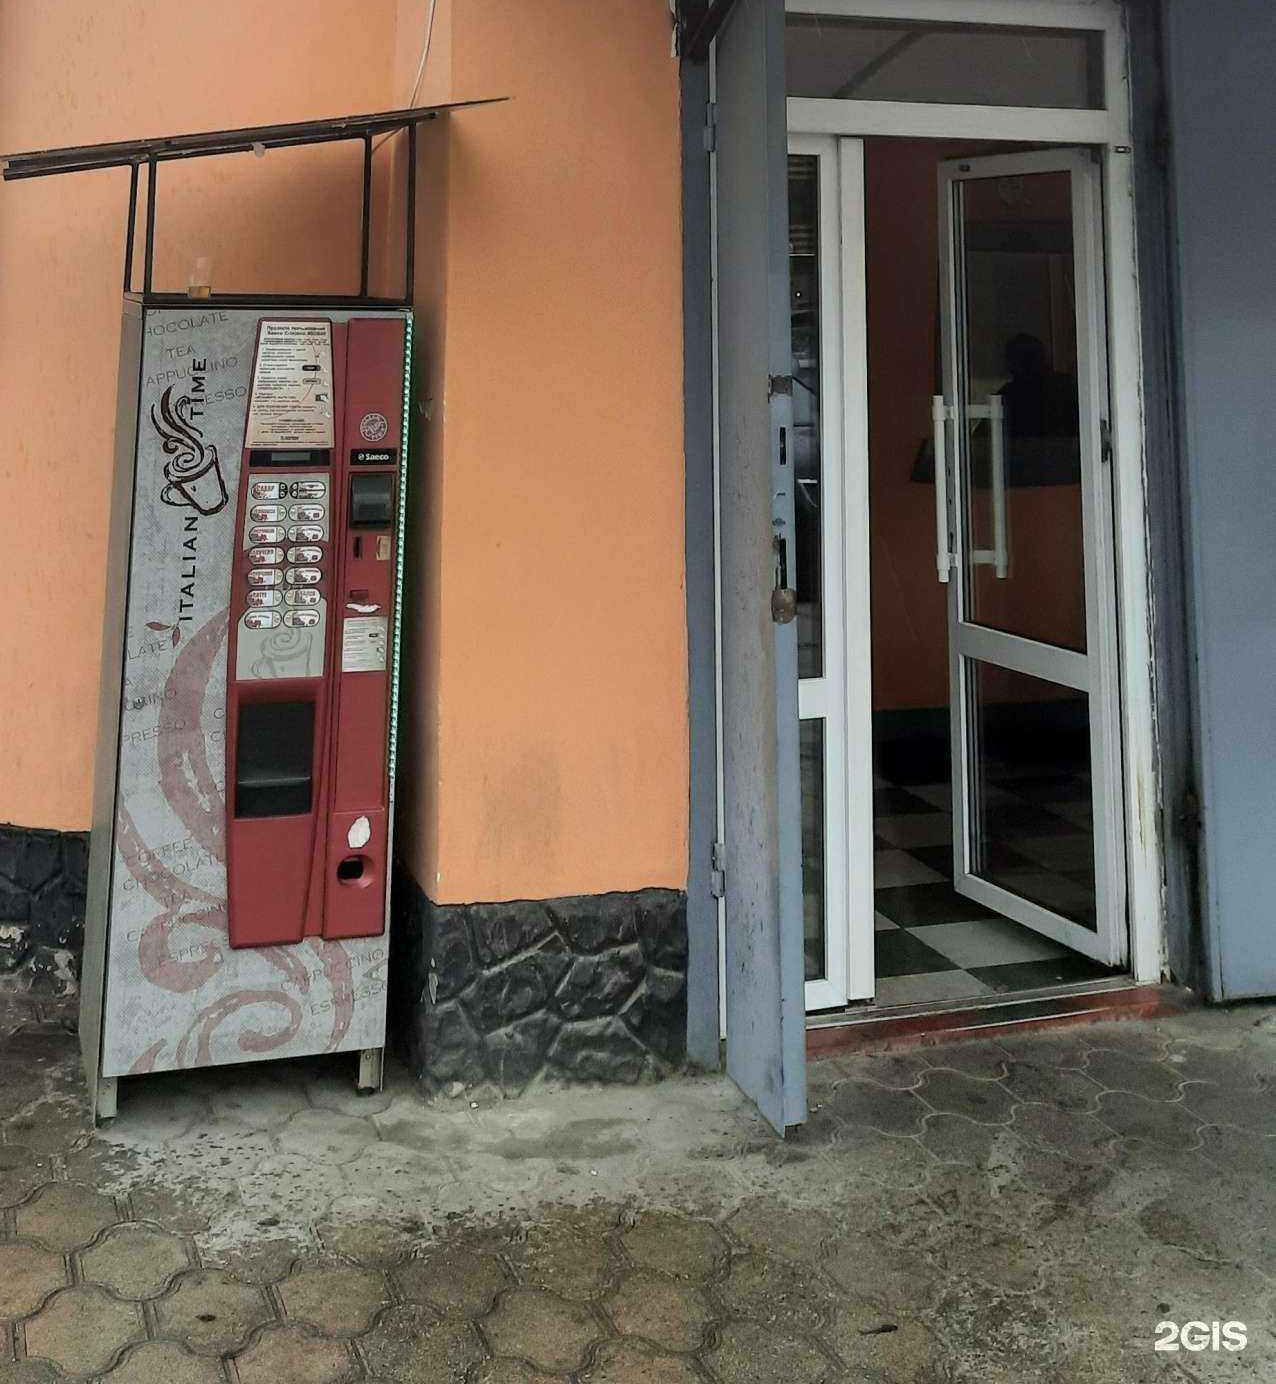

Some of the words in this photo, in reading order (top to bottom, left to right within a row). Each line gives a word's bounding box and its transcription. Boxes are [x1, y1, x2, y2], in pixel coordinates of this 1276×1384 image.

[179, 515, 199, 622] ITALIAN
[190, 358, 207, 421] TIME
[365, 452, 389, 461] Saeco
